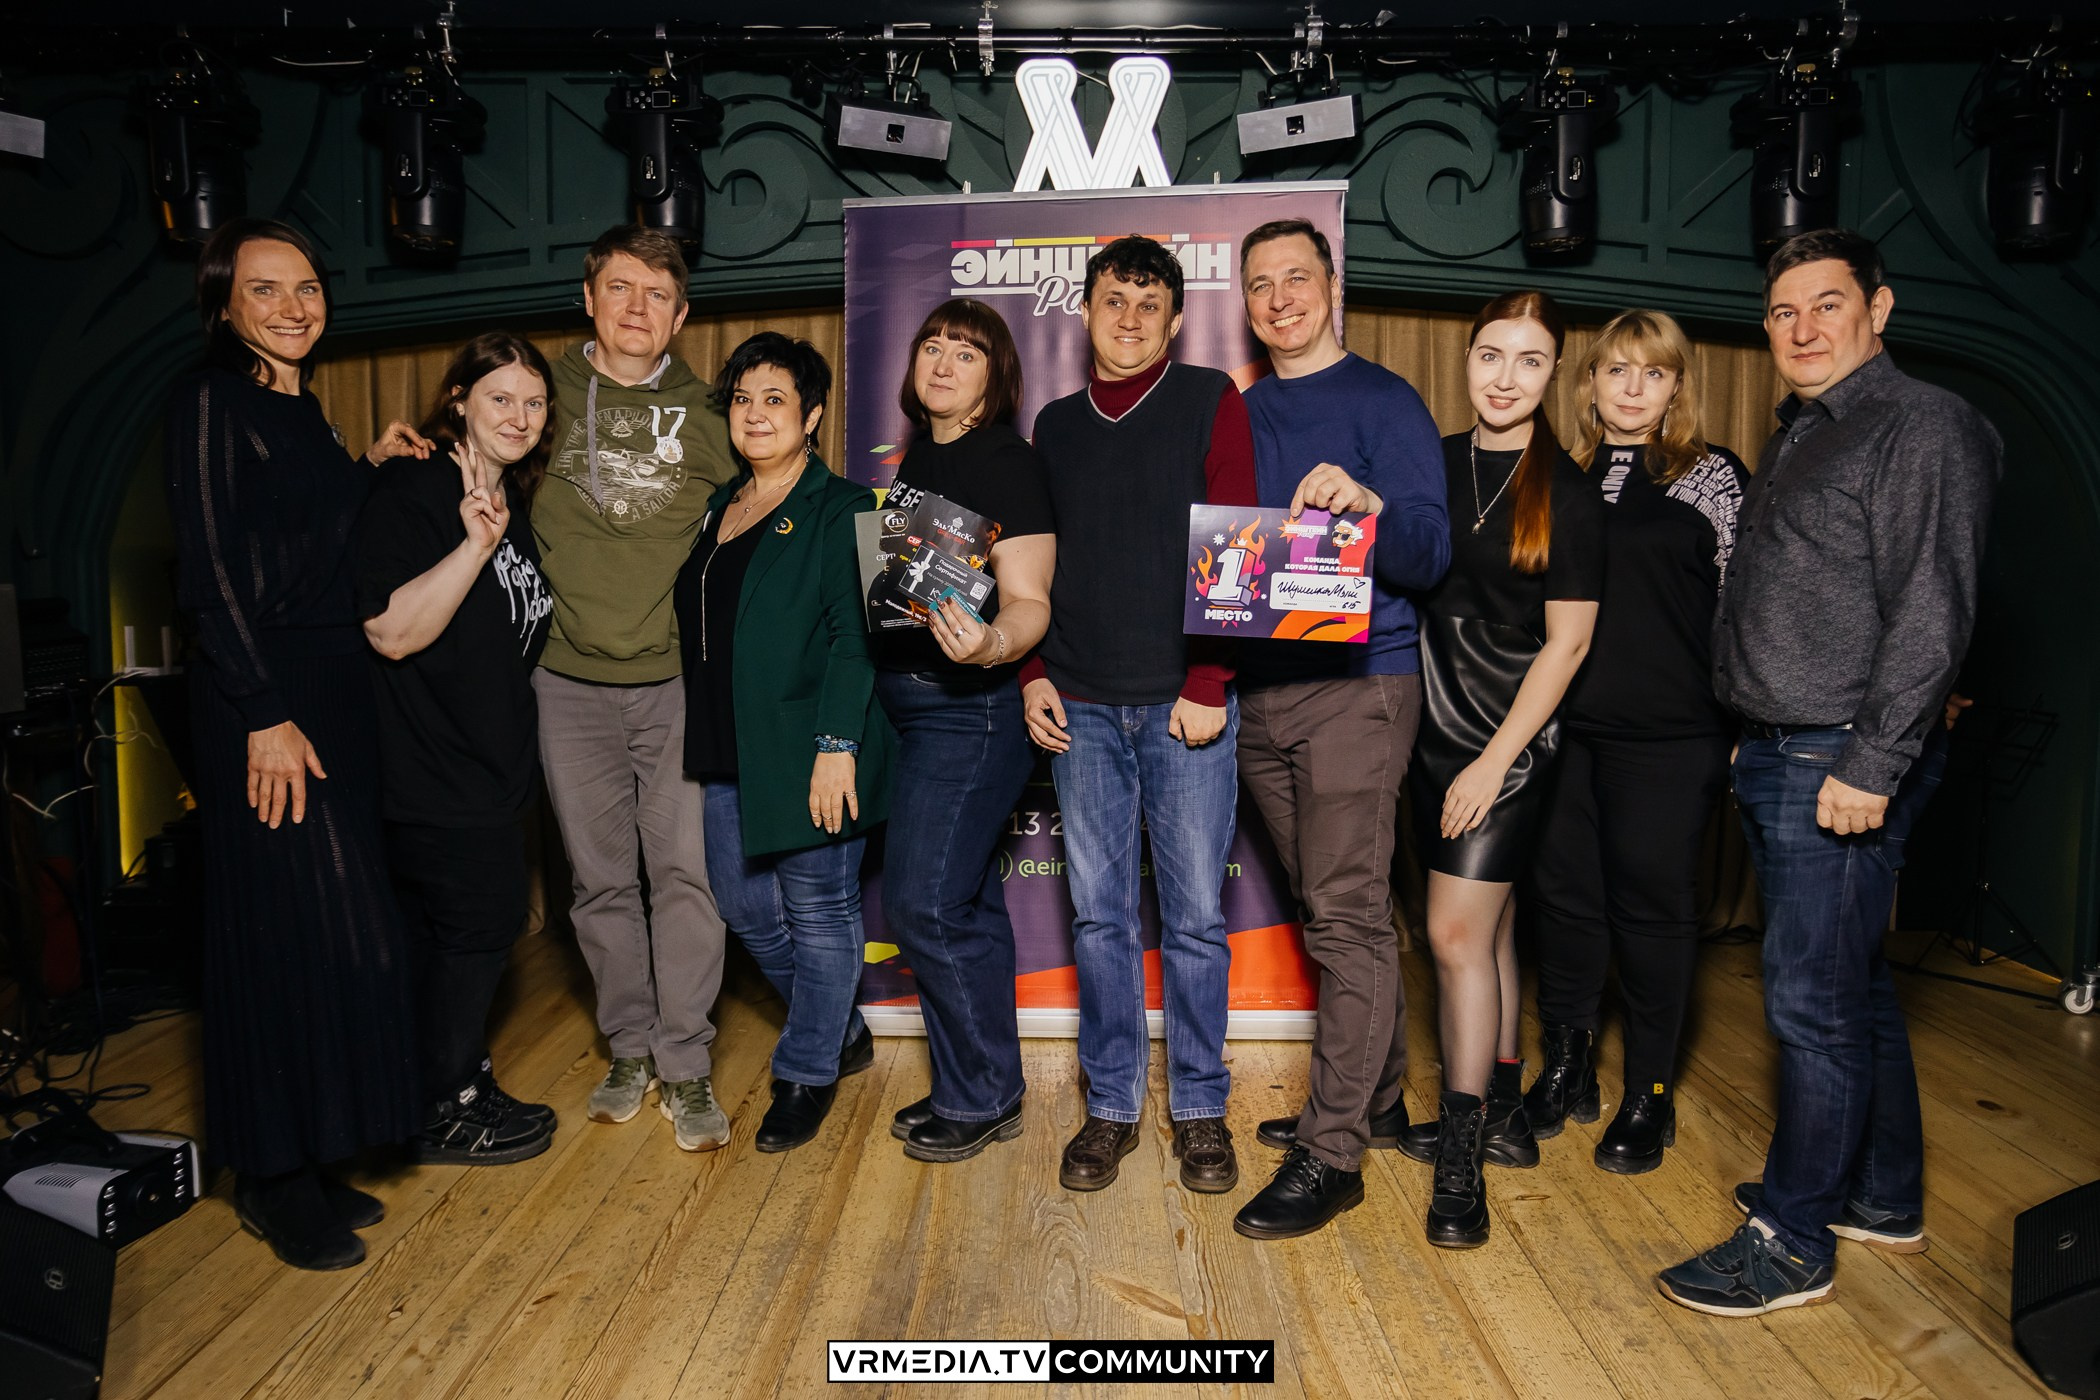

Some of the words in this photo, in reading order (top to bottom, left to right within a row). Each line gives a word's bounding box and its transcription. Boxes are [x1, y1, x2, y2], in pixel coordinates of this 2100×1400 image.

[951, 234, 1231, 285] ЭЙНШЙН
[648, 405, 688, 439] 17
[566, 423, 587, 449] TIME
[1696, 453, 1726, 471] HIS
[1716, 465, 1742, 494] CITY
[900, 487, 925, 508] БЕ
[1675, 478, 1697, 490] AND
[1696, 483, 1715, 499] YOU
[1675, 486, 1701, 506] YOUR
[632, 506, 642, 521] A
[642, 481, 681, 516] SAILOR
[891, 517, 905, 526] FLY
[935, 565, 967, 585] Сертификат
[1207, 547, 1255, 606] 1
[1284, 563, 1319, 572] КОТОРАЯ
[1319, 565, 1341, 573] ДАЛА
[1204, 608, 1253, 622] МЕСТО
[1653, 1083, 1664, 1094] B
